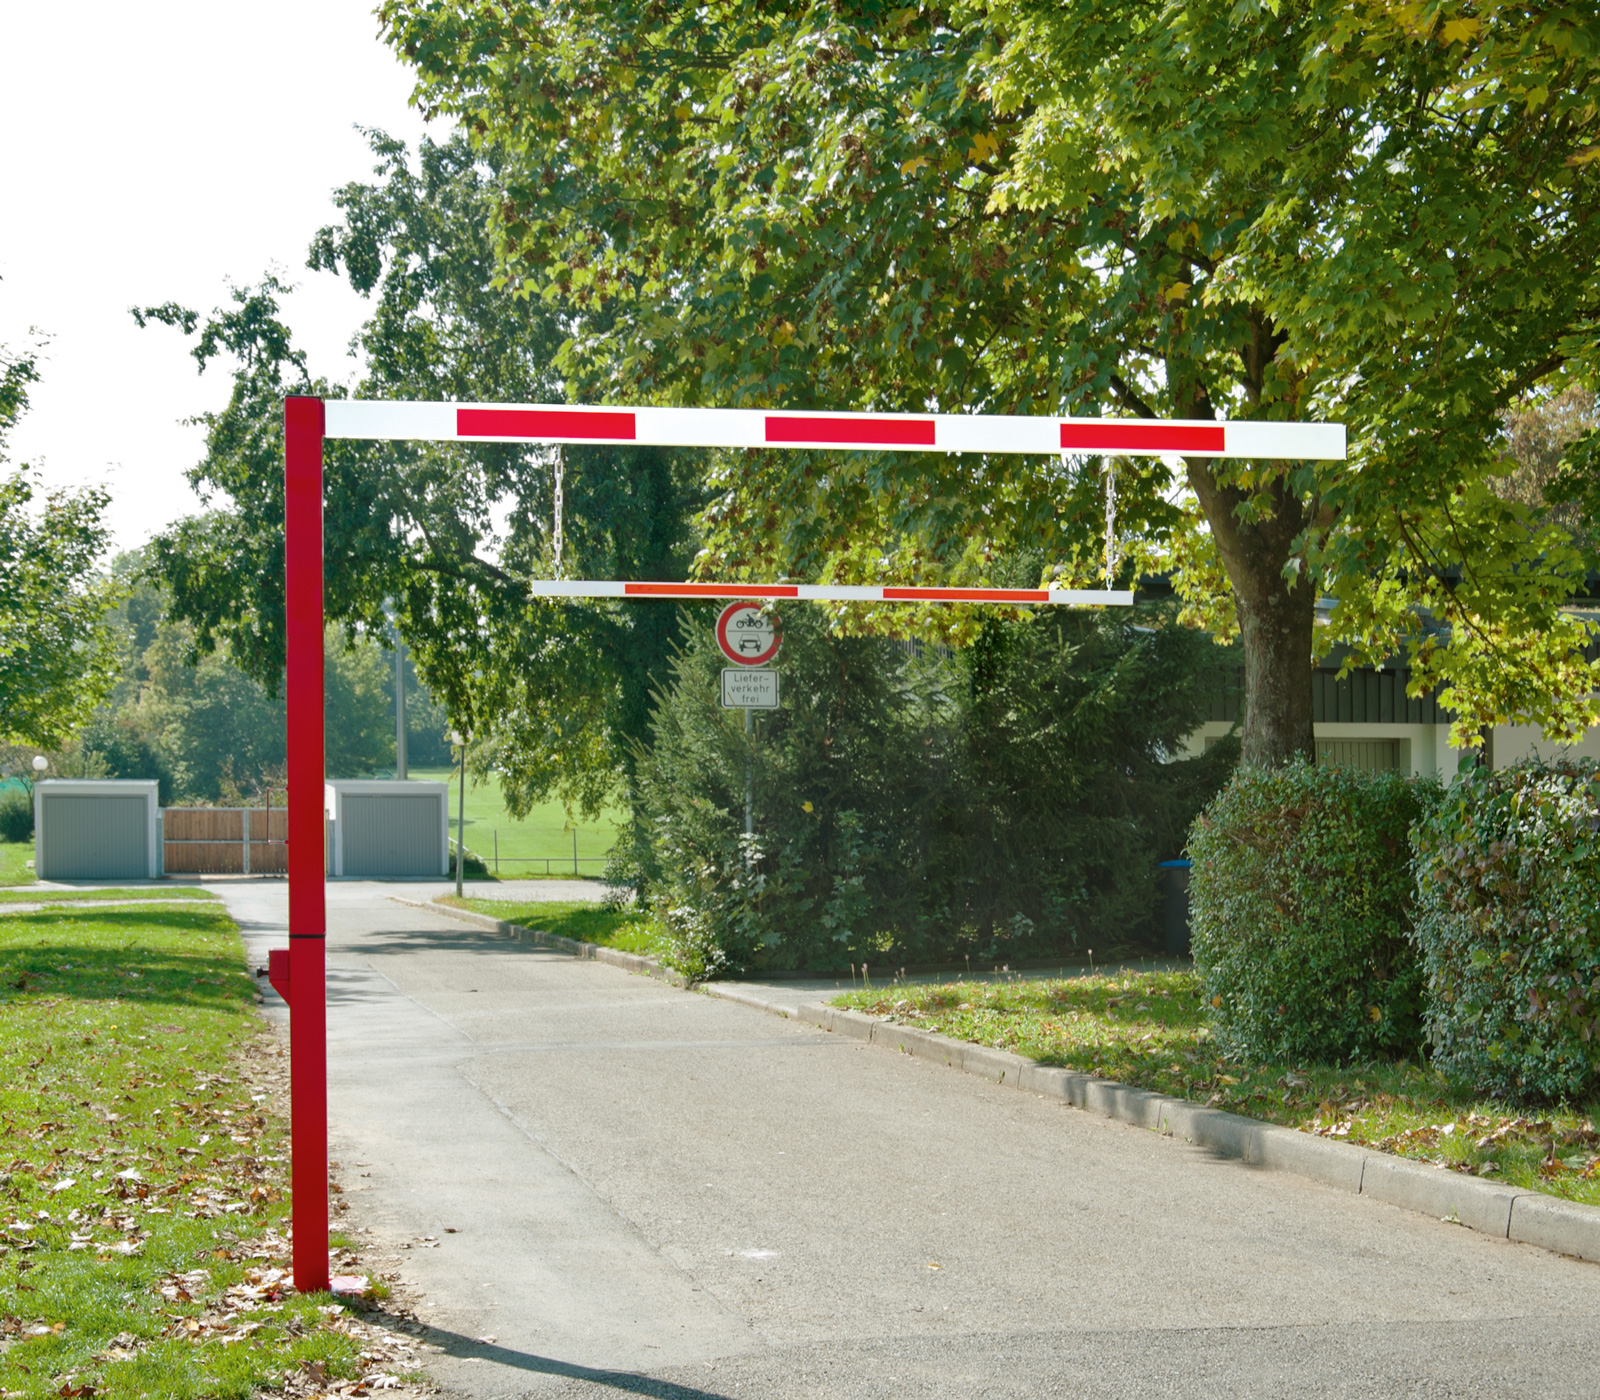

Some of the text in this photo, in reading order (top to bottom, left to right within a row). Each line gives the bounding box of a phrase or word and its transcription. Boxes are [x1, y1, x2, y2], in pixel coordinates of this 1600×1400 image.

[734, 673, 769, 682] Liefer-
[731, 684, 769, 693] verkehr
[742, 694, 759, 703] frei
